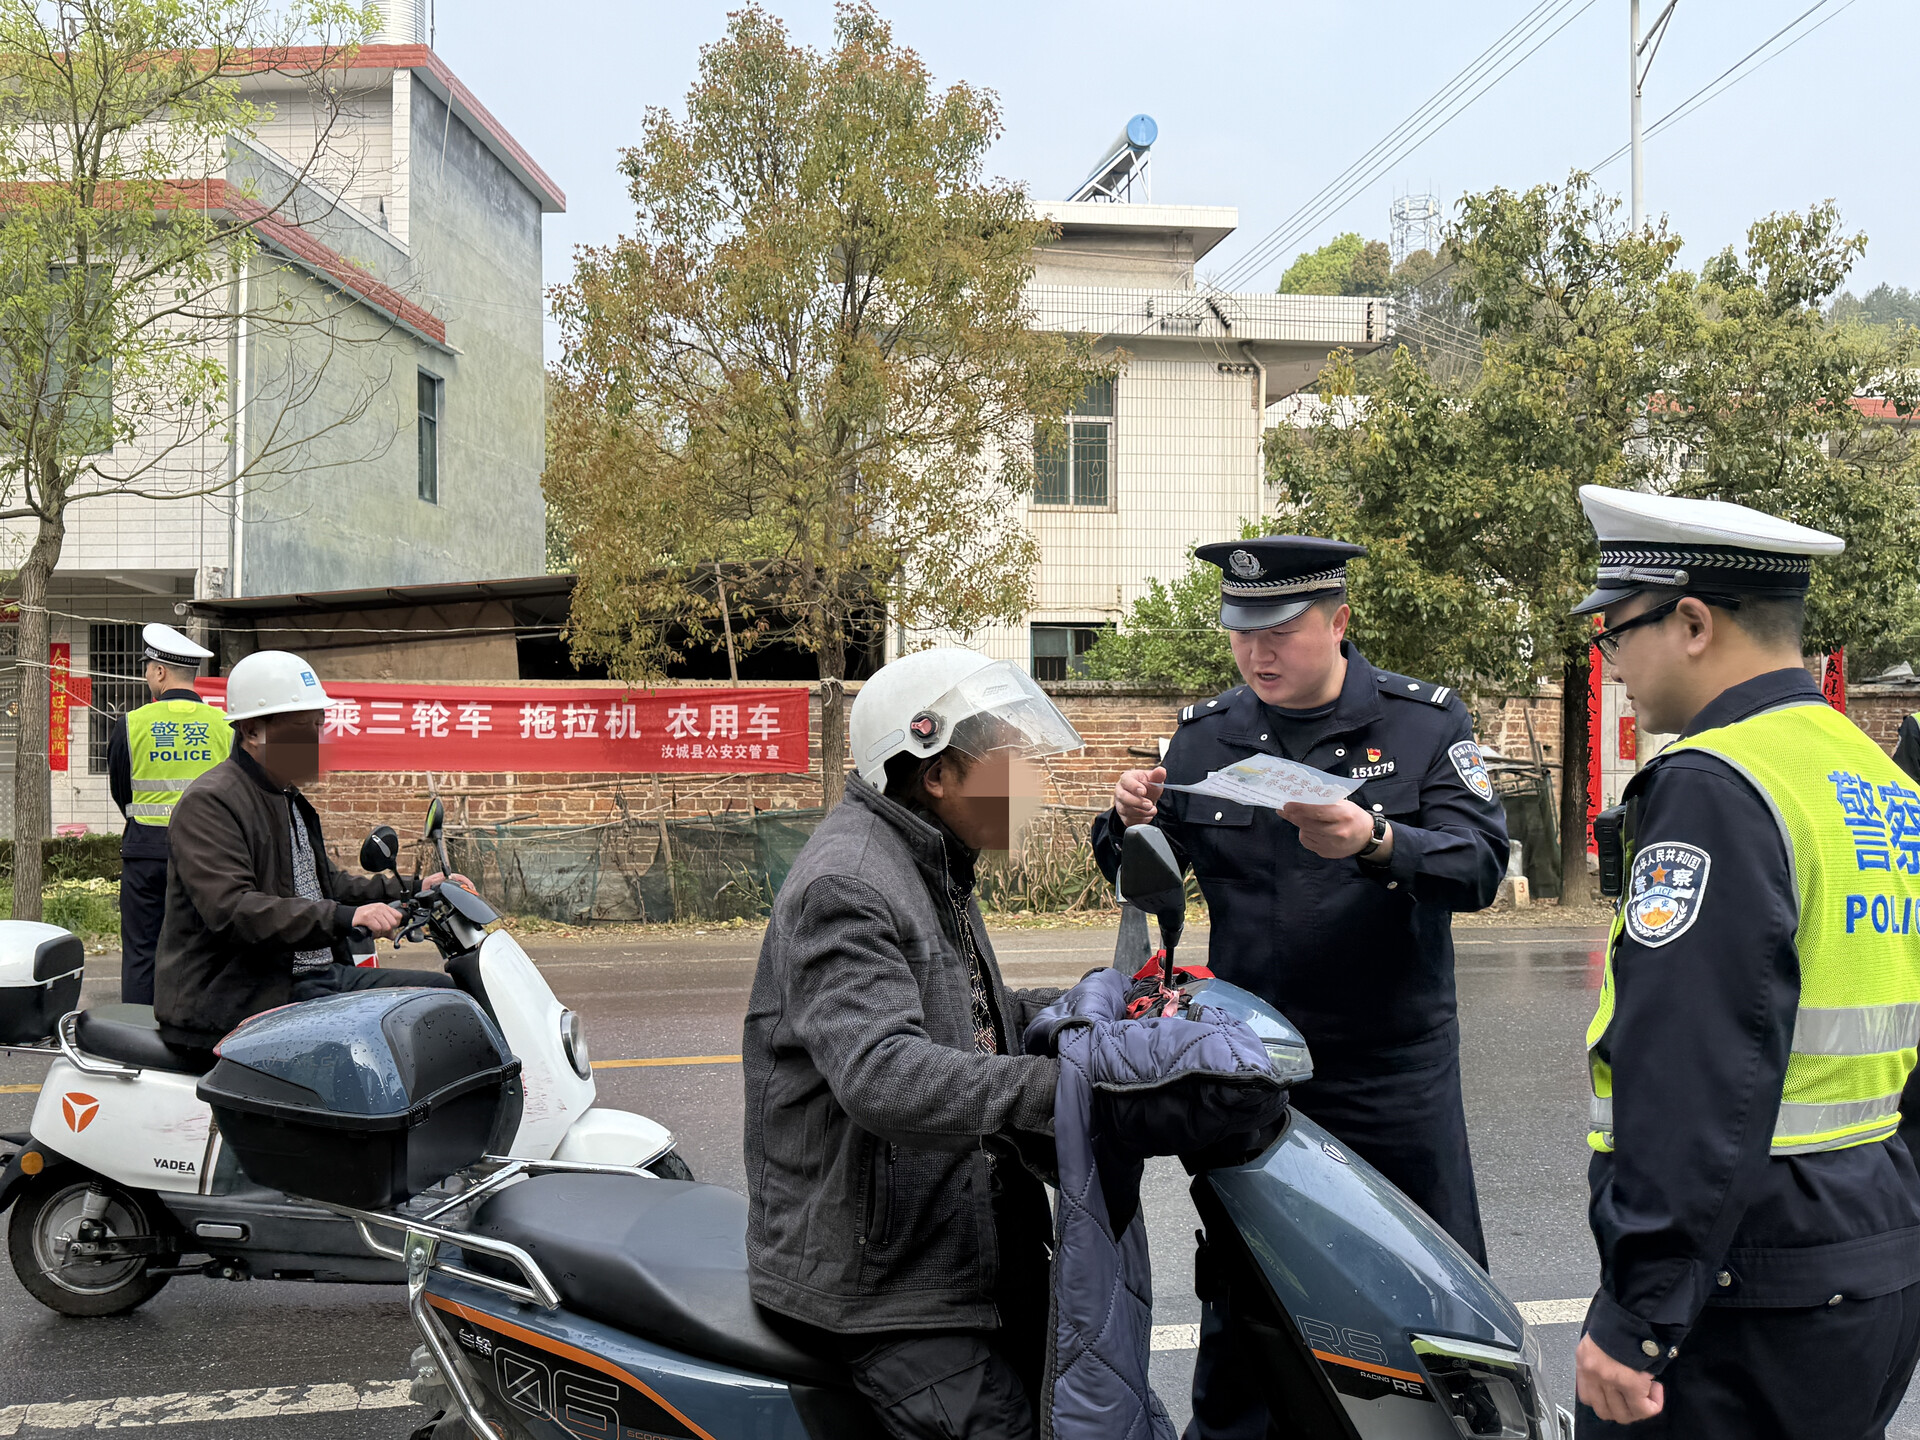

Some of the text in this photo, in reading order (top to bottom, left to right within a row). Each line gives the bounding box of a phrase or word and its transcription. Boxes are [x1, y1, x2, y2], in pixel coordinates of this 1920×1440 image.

[150, 721, 209, 747] 警察
[519, 702, 641, 739] 拖拉机
[665, 703, 781, 740] 农用车
[150, 750, 211, 762] POLICE
[1352, 761, 1395, 779] 151279
[1827, 771, 1920, 875] 警察
[1846, 894, 1920, 934] POLI
[153, 1158, 196, 1171] YADEA
[1296, 1315, 1388, 1365] RS
[1360, 1371, 1423, 1395] RACING RS
